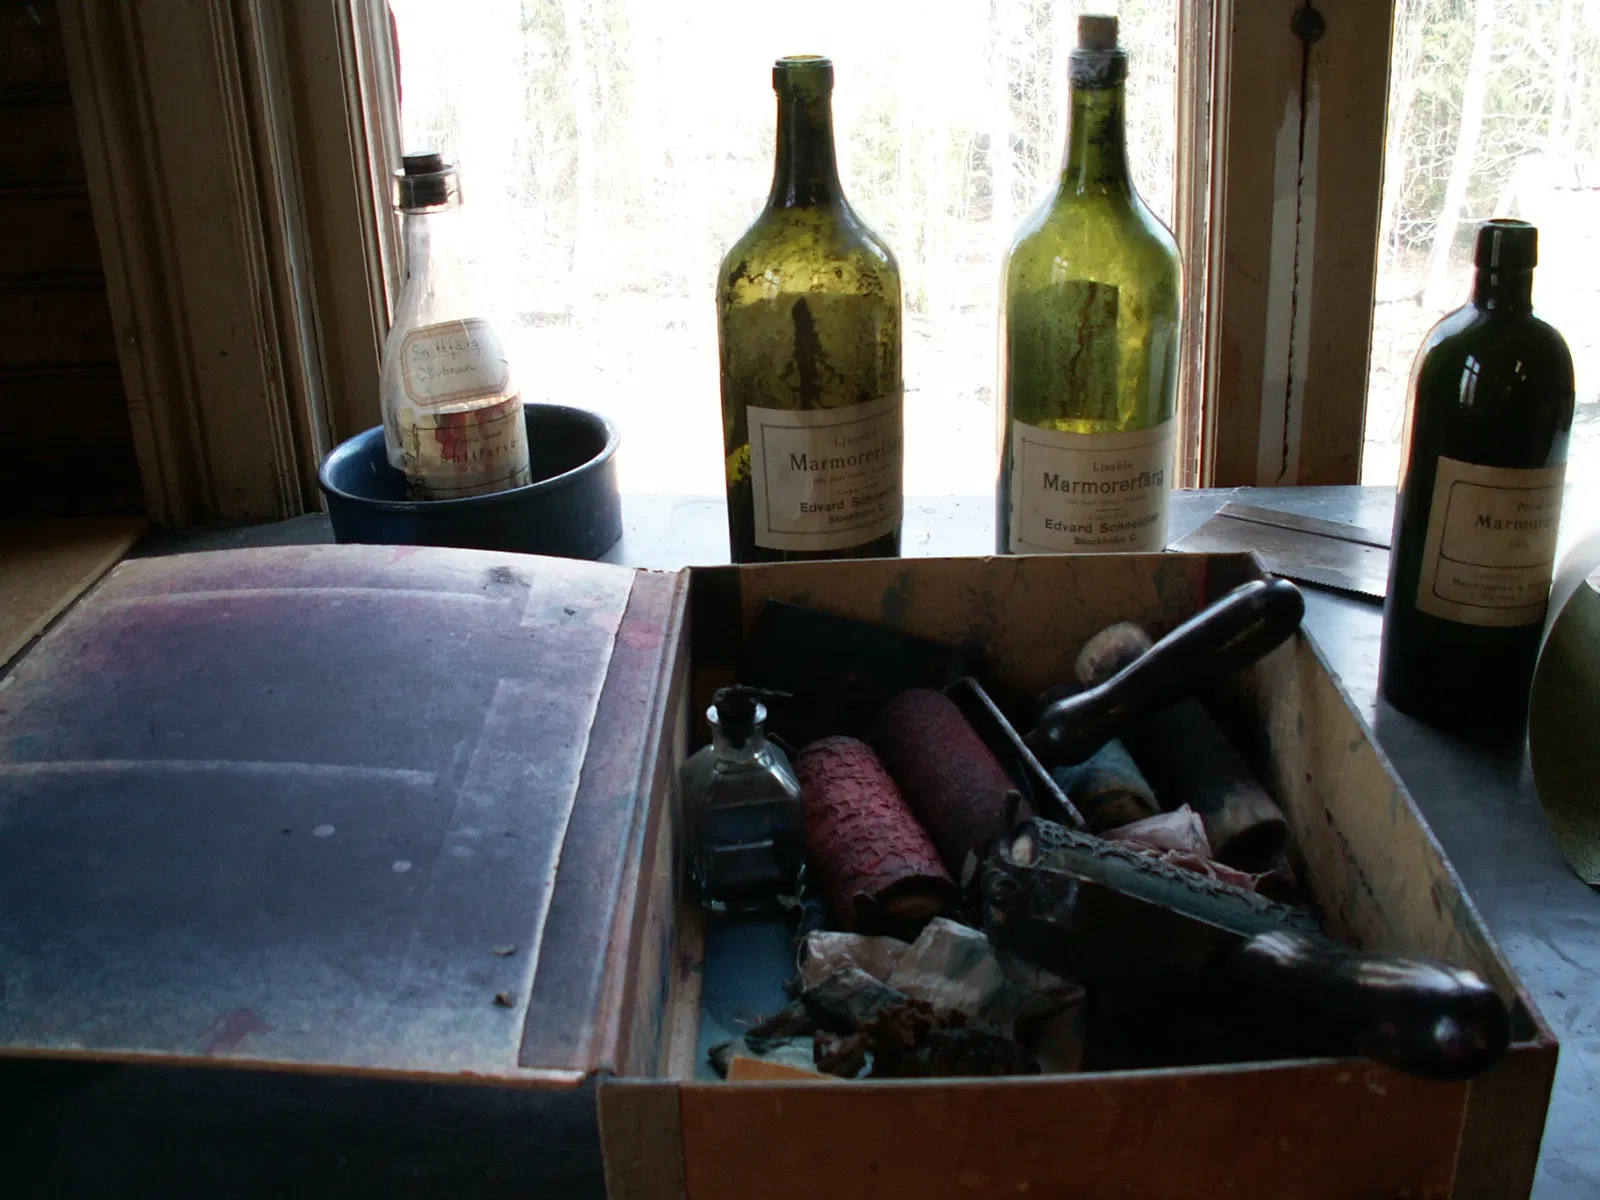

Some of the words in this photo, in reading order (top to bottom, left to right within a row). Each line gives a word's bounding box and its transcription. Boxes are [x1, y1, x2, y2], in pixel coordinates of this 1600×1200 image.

[1043, 470, 1164, 494] Marmorerfärg
[800, 500, 844, 513] Edvard
[1044, 517, 1093, 533] Edvard
